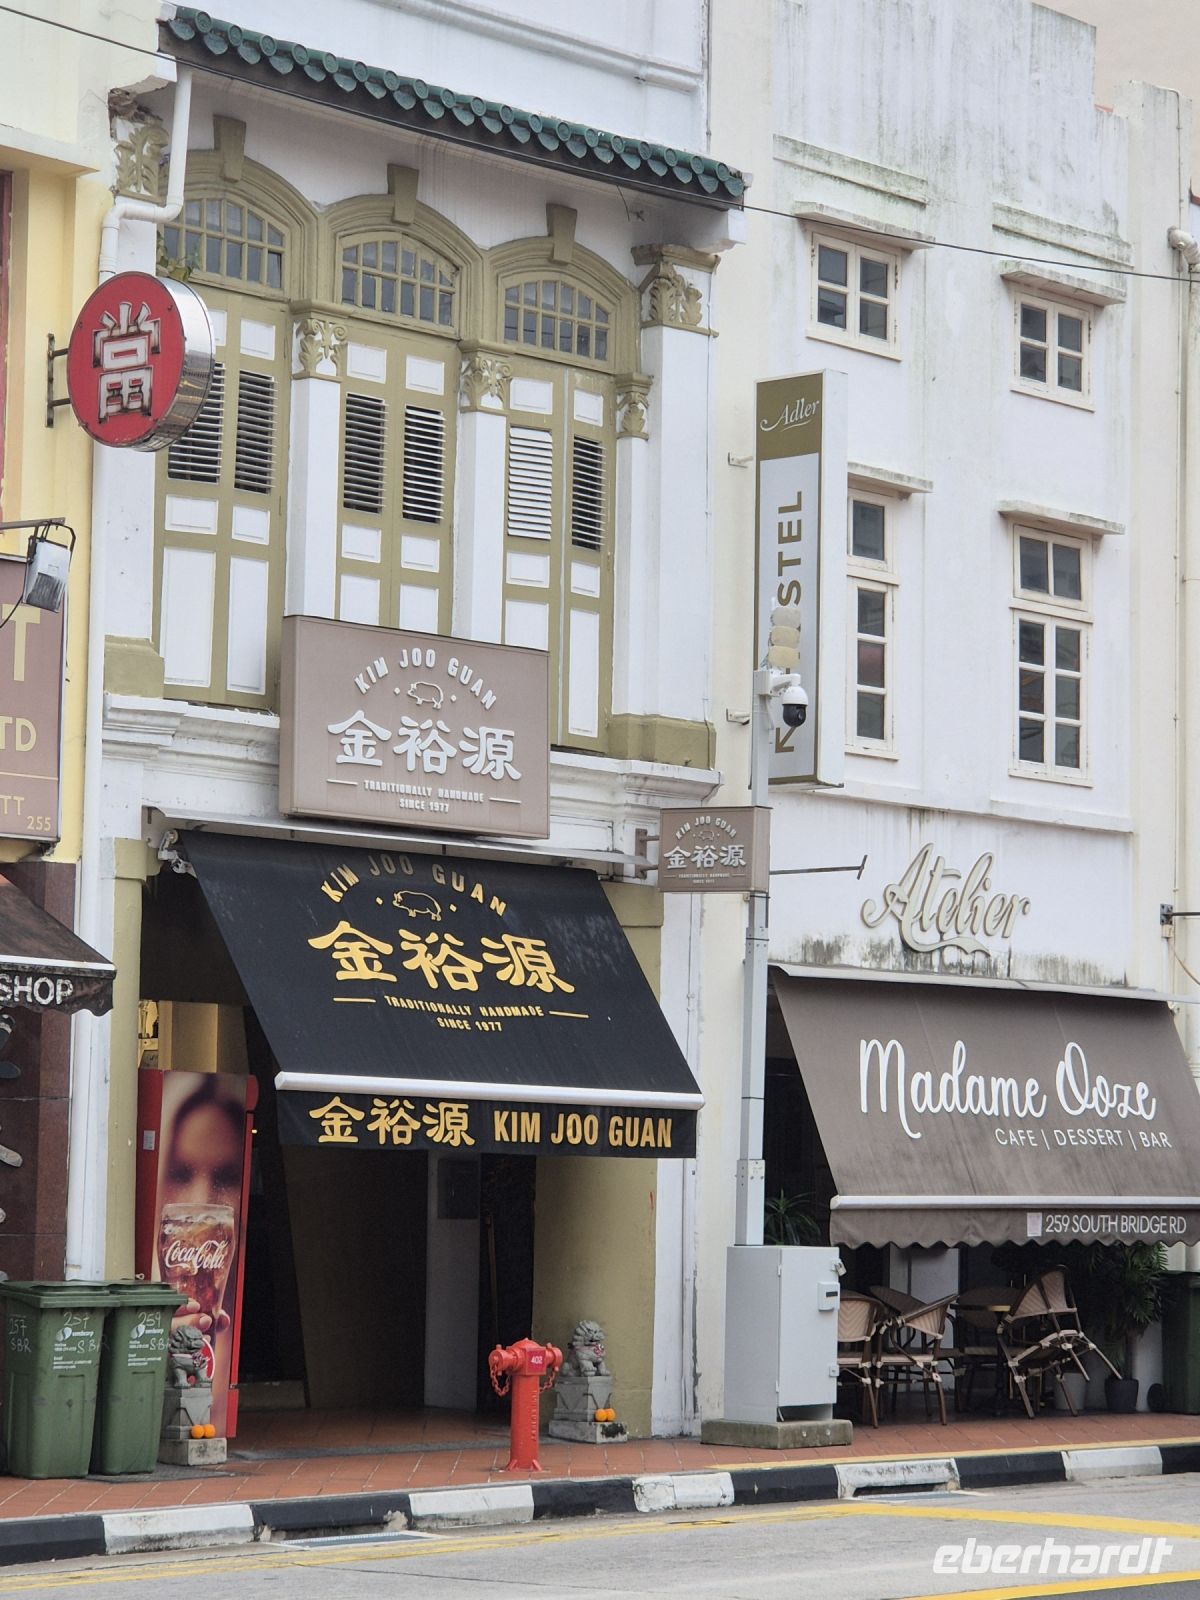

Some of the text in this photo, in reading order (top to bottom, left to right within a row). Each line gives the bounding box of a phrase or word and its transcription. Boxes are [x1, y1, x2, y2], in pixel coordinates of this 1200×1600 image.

[759, 397, 820, 432] Adler
[354, 647, 497, 710] KIM JOO GUAN
[327, 710, 522, 780] 金裕源
[364, 779, 432, 797] TRADITIONALLY
[400, 798, 449, 813] SINCE 1977
[27, 815, 51, 831] 255
[694, 815, 711, 826] JOO
[715, 817, 737, 838] GUAN
[663, 844, 747, 869] 金裕源
[321, 853, 507, 917] KIM JOO GUAN
[860, 842, 1031, 957] Atelier
[307, 920, 575, 994] 金裕源
[0, 973, 74, 1005] SHOP
[384, 995, 545, 1017] TRADITIONALLY HANDMADE
[437, 1017, 503, 1032] SINCE 1977
[859, 1038, 1156, 1139] Madame Ooze
[308, 1095, 673, 1149] 金裕源 KIM JOO GUAN
[994, 1127, 1172, 1148] CAFE DESSERT BAR
[1045, 1214, 1187, 1234] 259 SOUTH BRIDGE RD
[165, 1240, 227, 1275] Coca-Cola
[138, 1311, 161, 1328] 259
[11, 1337, 32, 1353] SBR
[531, 1355, 543, 1364] 402
